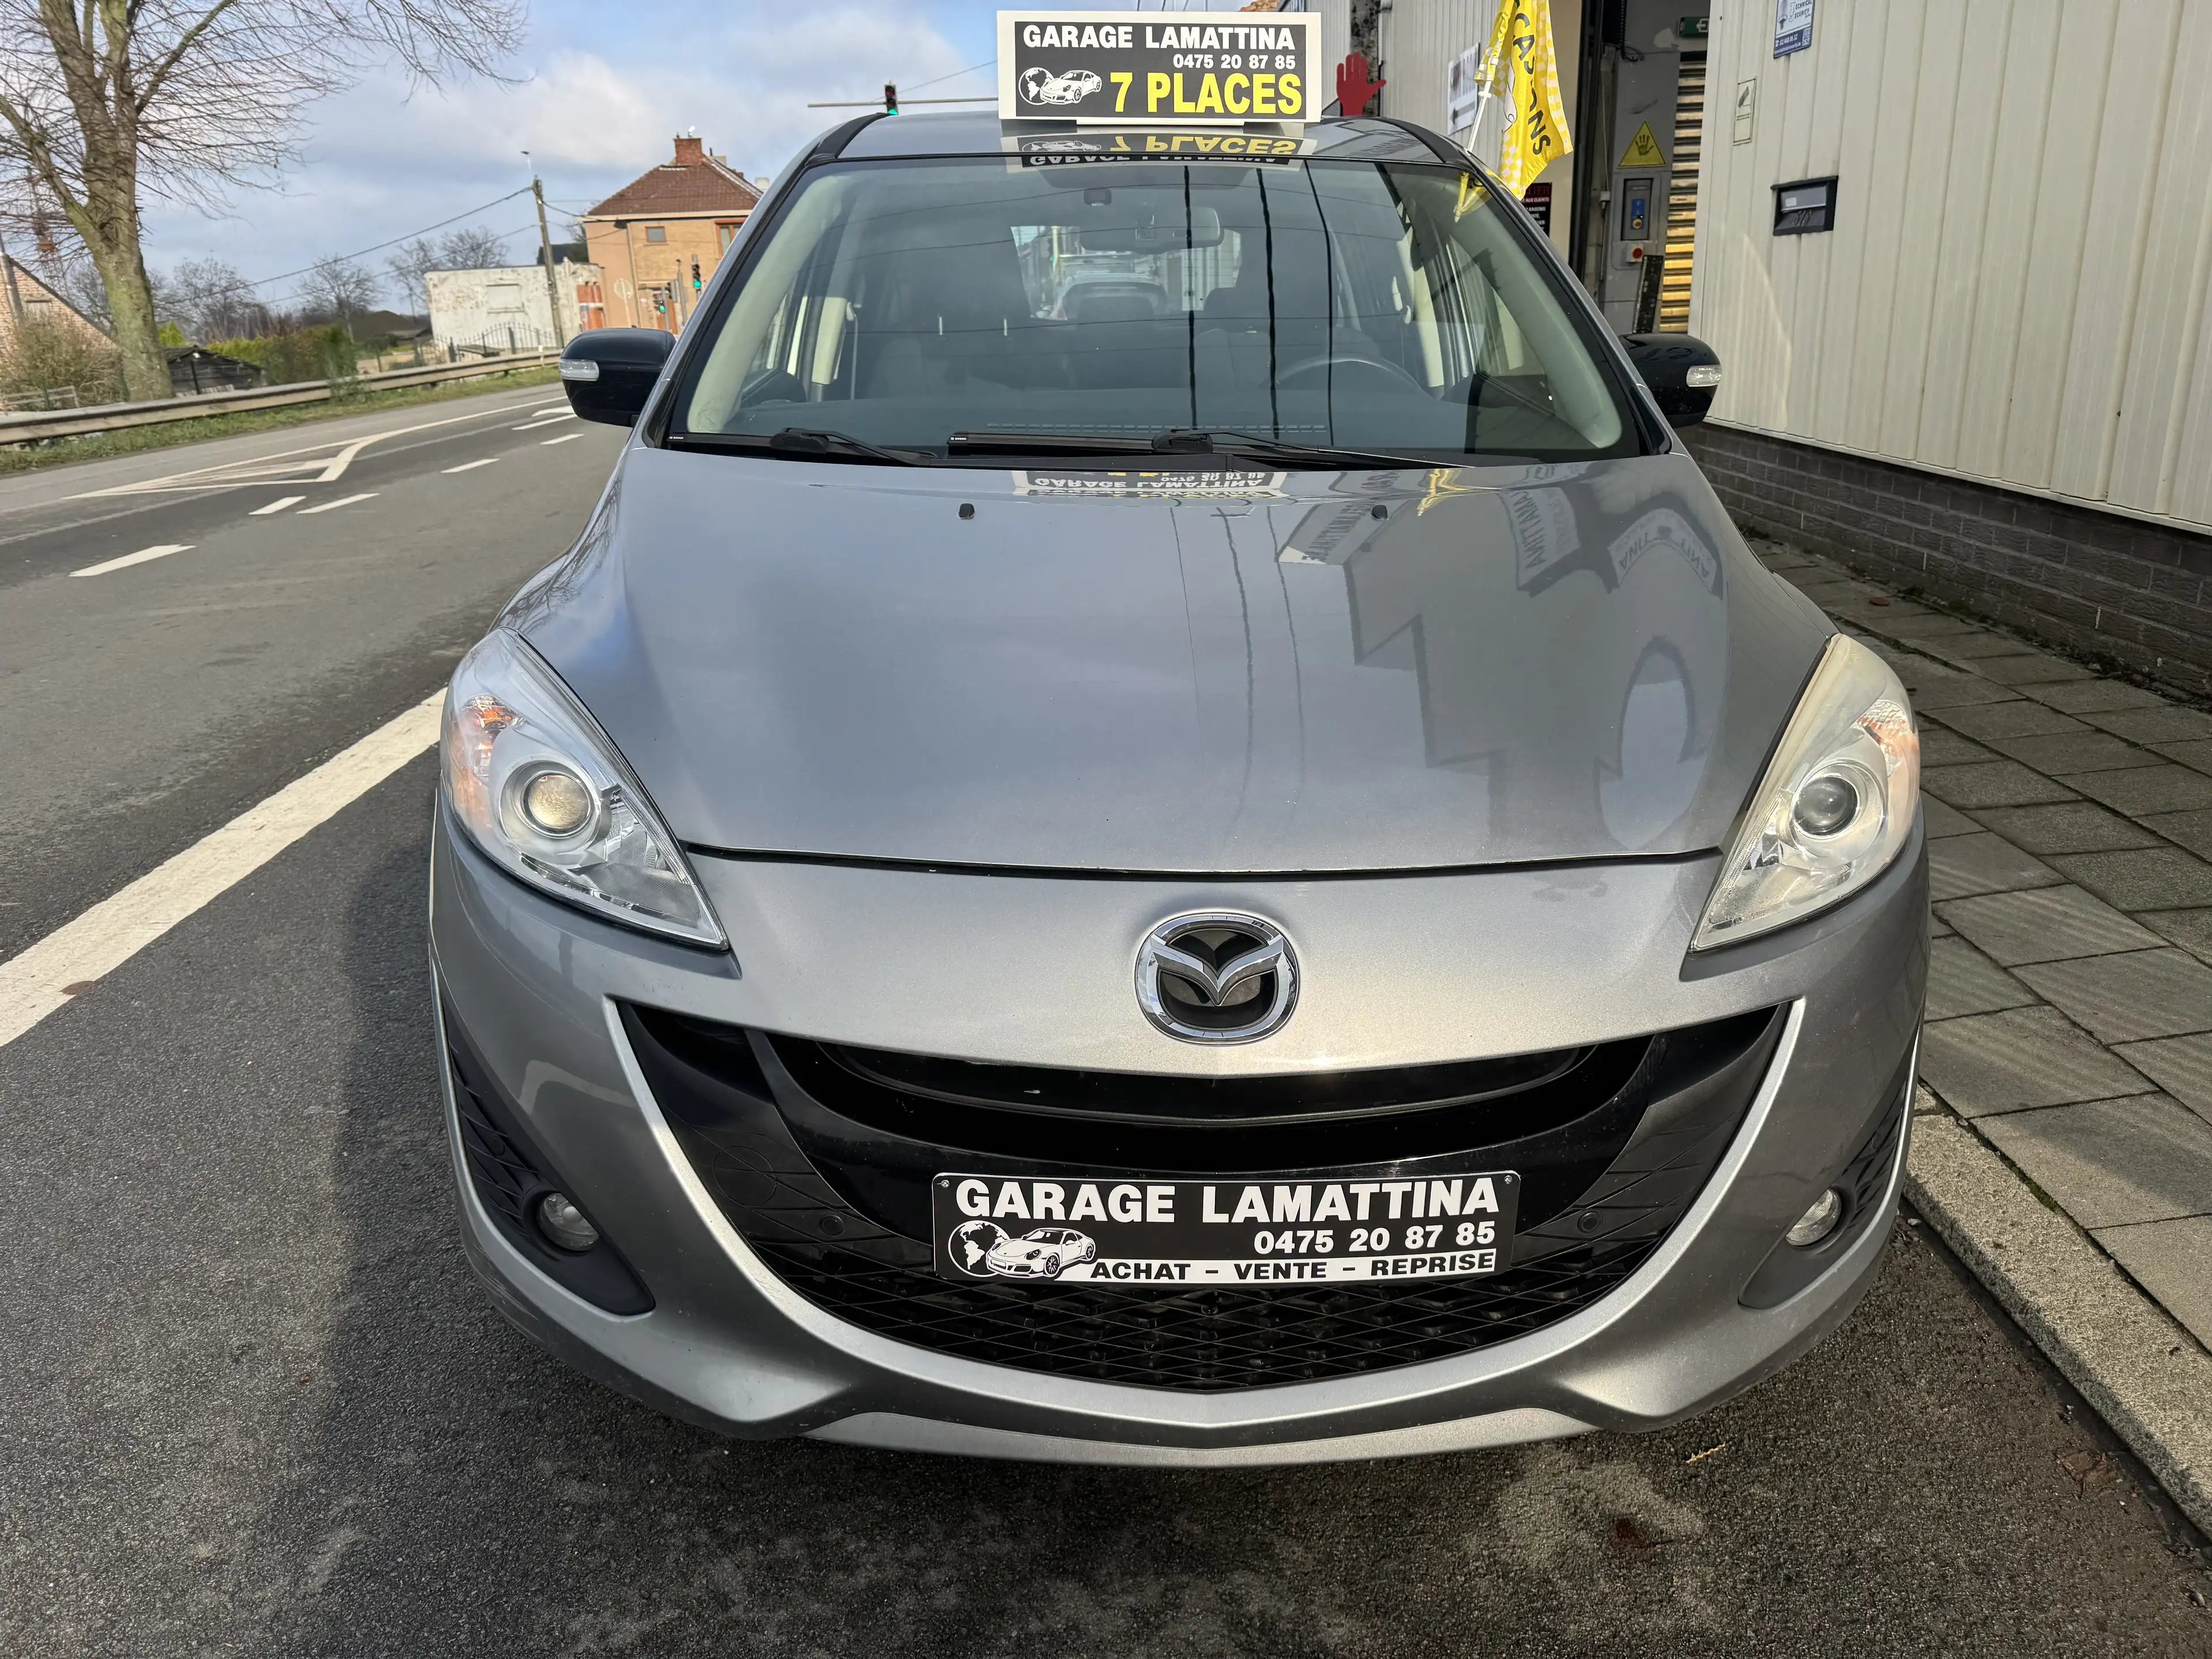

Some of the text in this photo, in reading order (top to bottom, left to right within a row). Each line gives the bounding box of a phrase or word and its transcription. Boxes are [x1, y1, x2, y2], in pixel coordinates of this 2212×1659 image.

[1023, 24, 1296, 50] GARAGE LAMATTINA
[1173, 54, 1296, 70] 0475 20 87 85
[1110, 72, 1302, 115] 7 PLACES
[956, 1177, 1499, 1223] GARAGE LAMATTINA
[1254, 1221, 1495, 1255] 0475 20 87 85
[1090, 1262, 1191, 1280] ACHAT
[1233, 1262, 1327, 1280] VENTE
[1370, 1252, 1494, 1277] REPRISE
